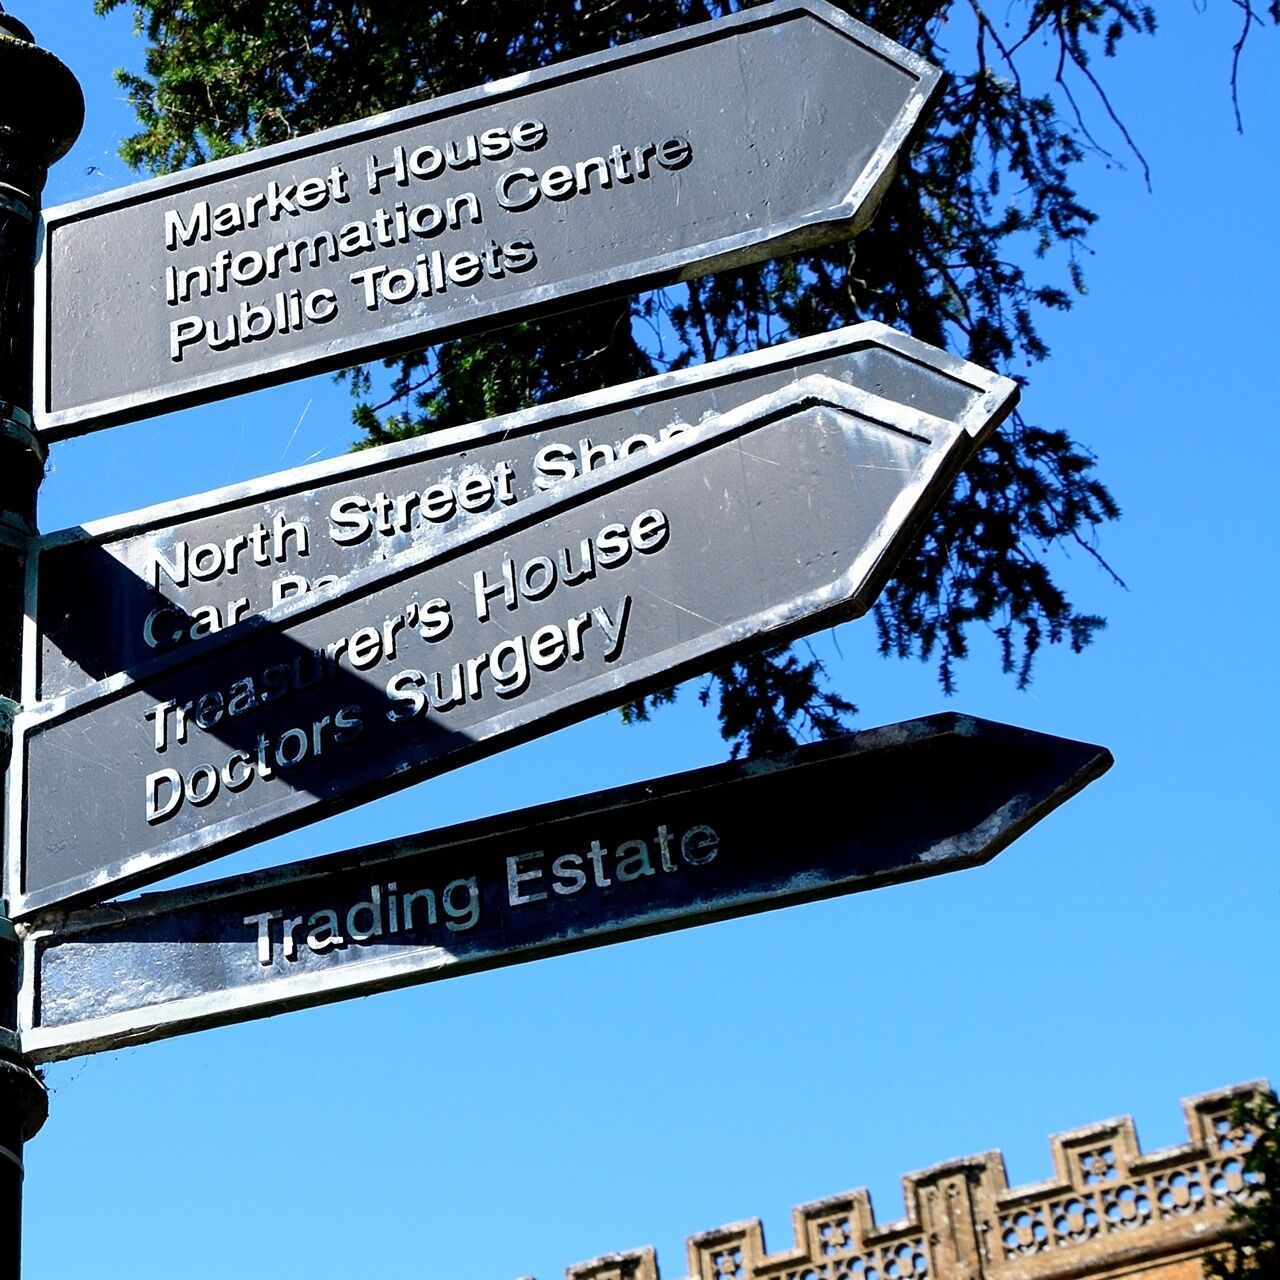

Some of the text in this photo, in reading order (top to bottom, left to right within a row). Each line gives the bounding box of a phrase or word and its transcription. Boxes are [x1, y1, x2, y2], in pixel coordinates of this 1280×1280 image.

[164, 118, 547, 251] Market House
[164, 135, 693, 307] Information Centre
[171, 237, 538, 362] Public Toilets
[145, 516, 310, 592] North
[330, 460, 514, 546] Street
[143, 596, 250, 649] Car
[144, 507, 671, 752] Treasurer's House
[144, 594, 632, 826] Doctors Surgery
[243, 823, 721, 967] Trading Estate
